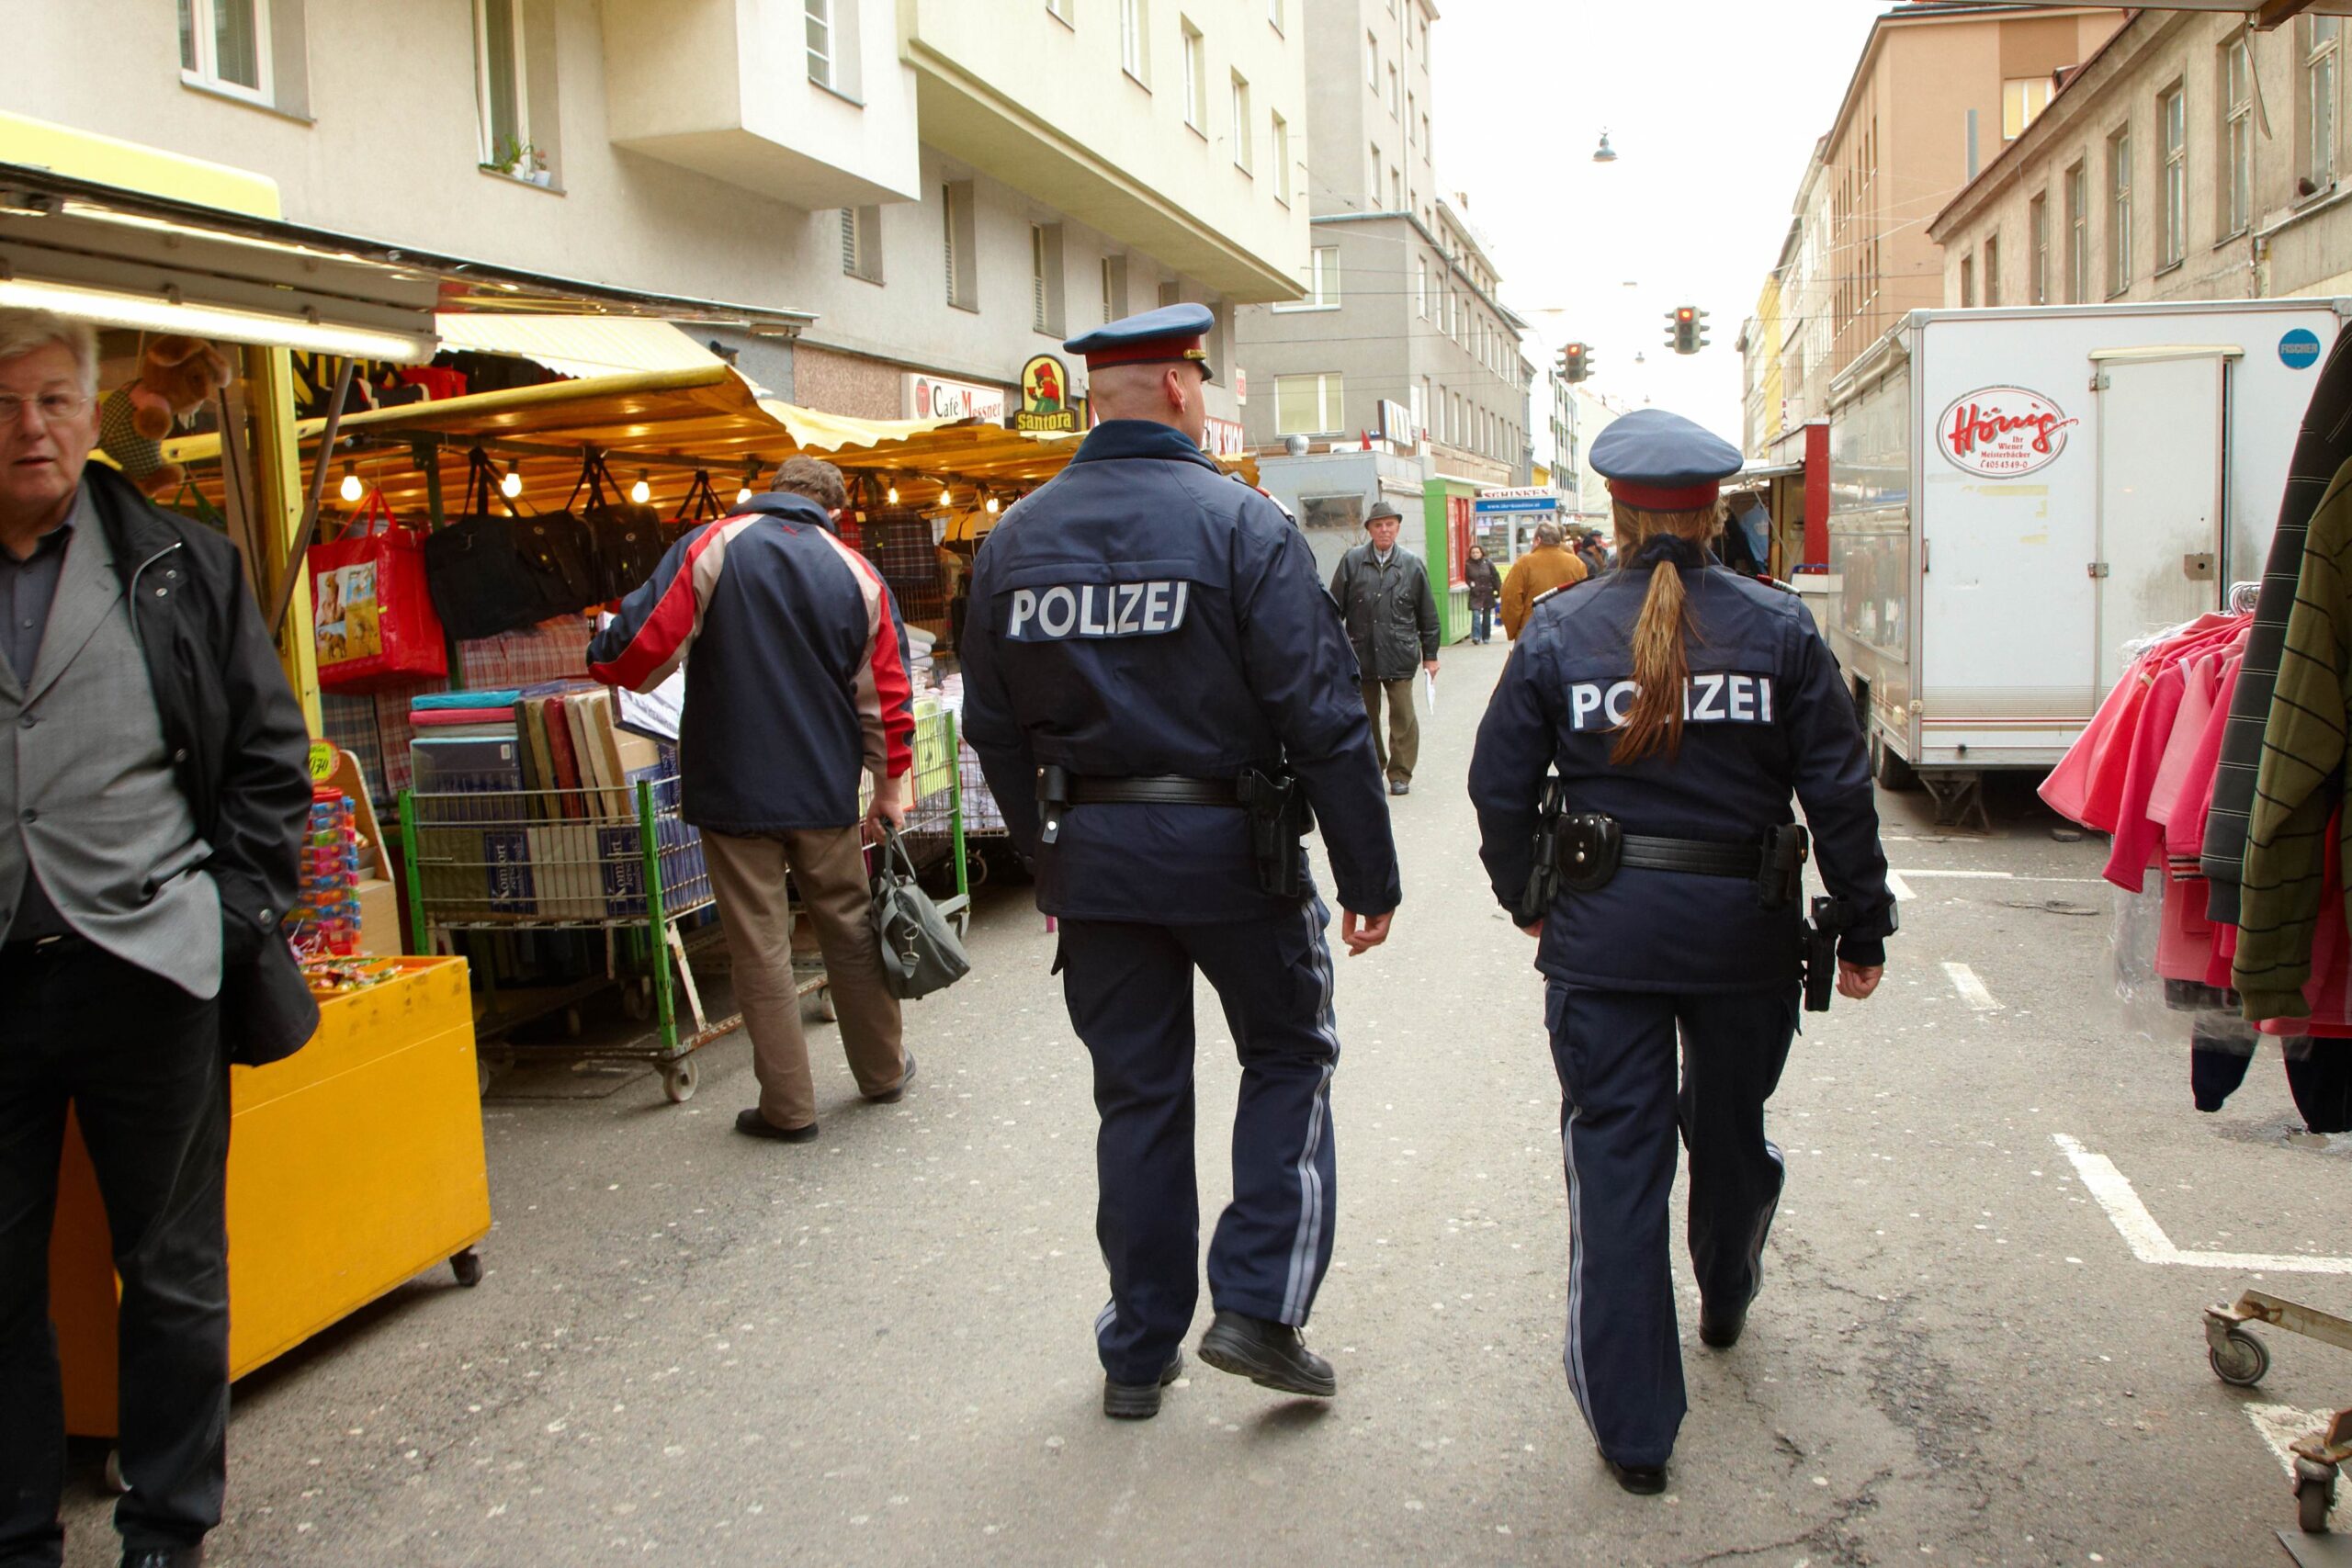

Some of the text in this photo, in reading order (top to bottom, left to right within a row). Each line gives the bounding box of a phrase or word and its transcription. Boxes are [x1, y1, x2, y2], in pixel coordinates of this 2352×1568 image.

[933, 385, 1001, 420] Café Messner
[1947, 402, 2079, 457] Hönig
[1484, 490, 1549, 498] SCHINKEN
[1011, 581, 1188, 637] POLIZEI
[1571, 673, 1772, 730] POIZEI
